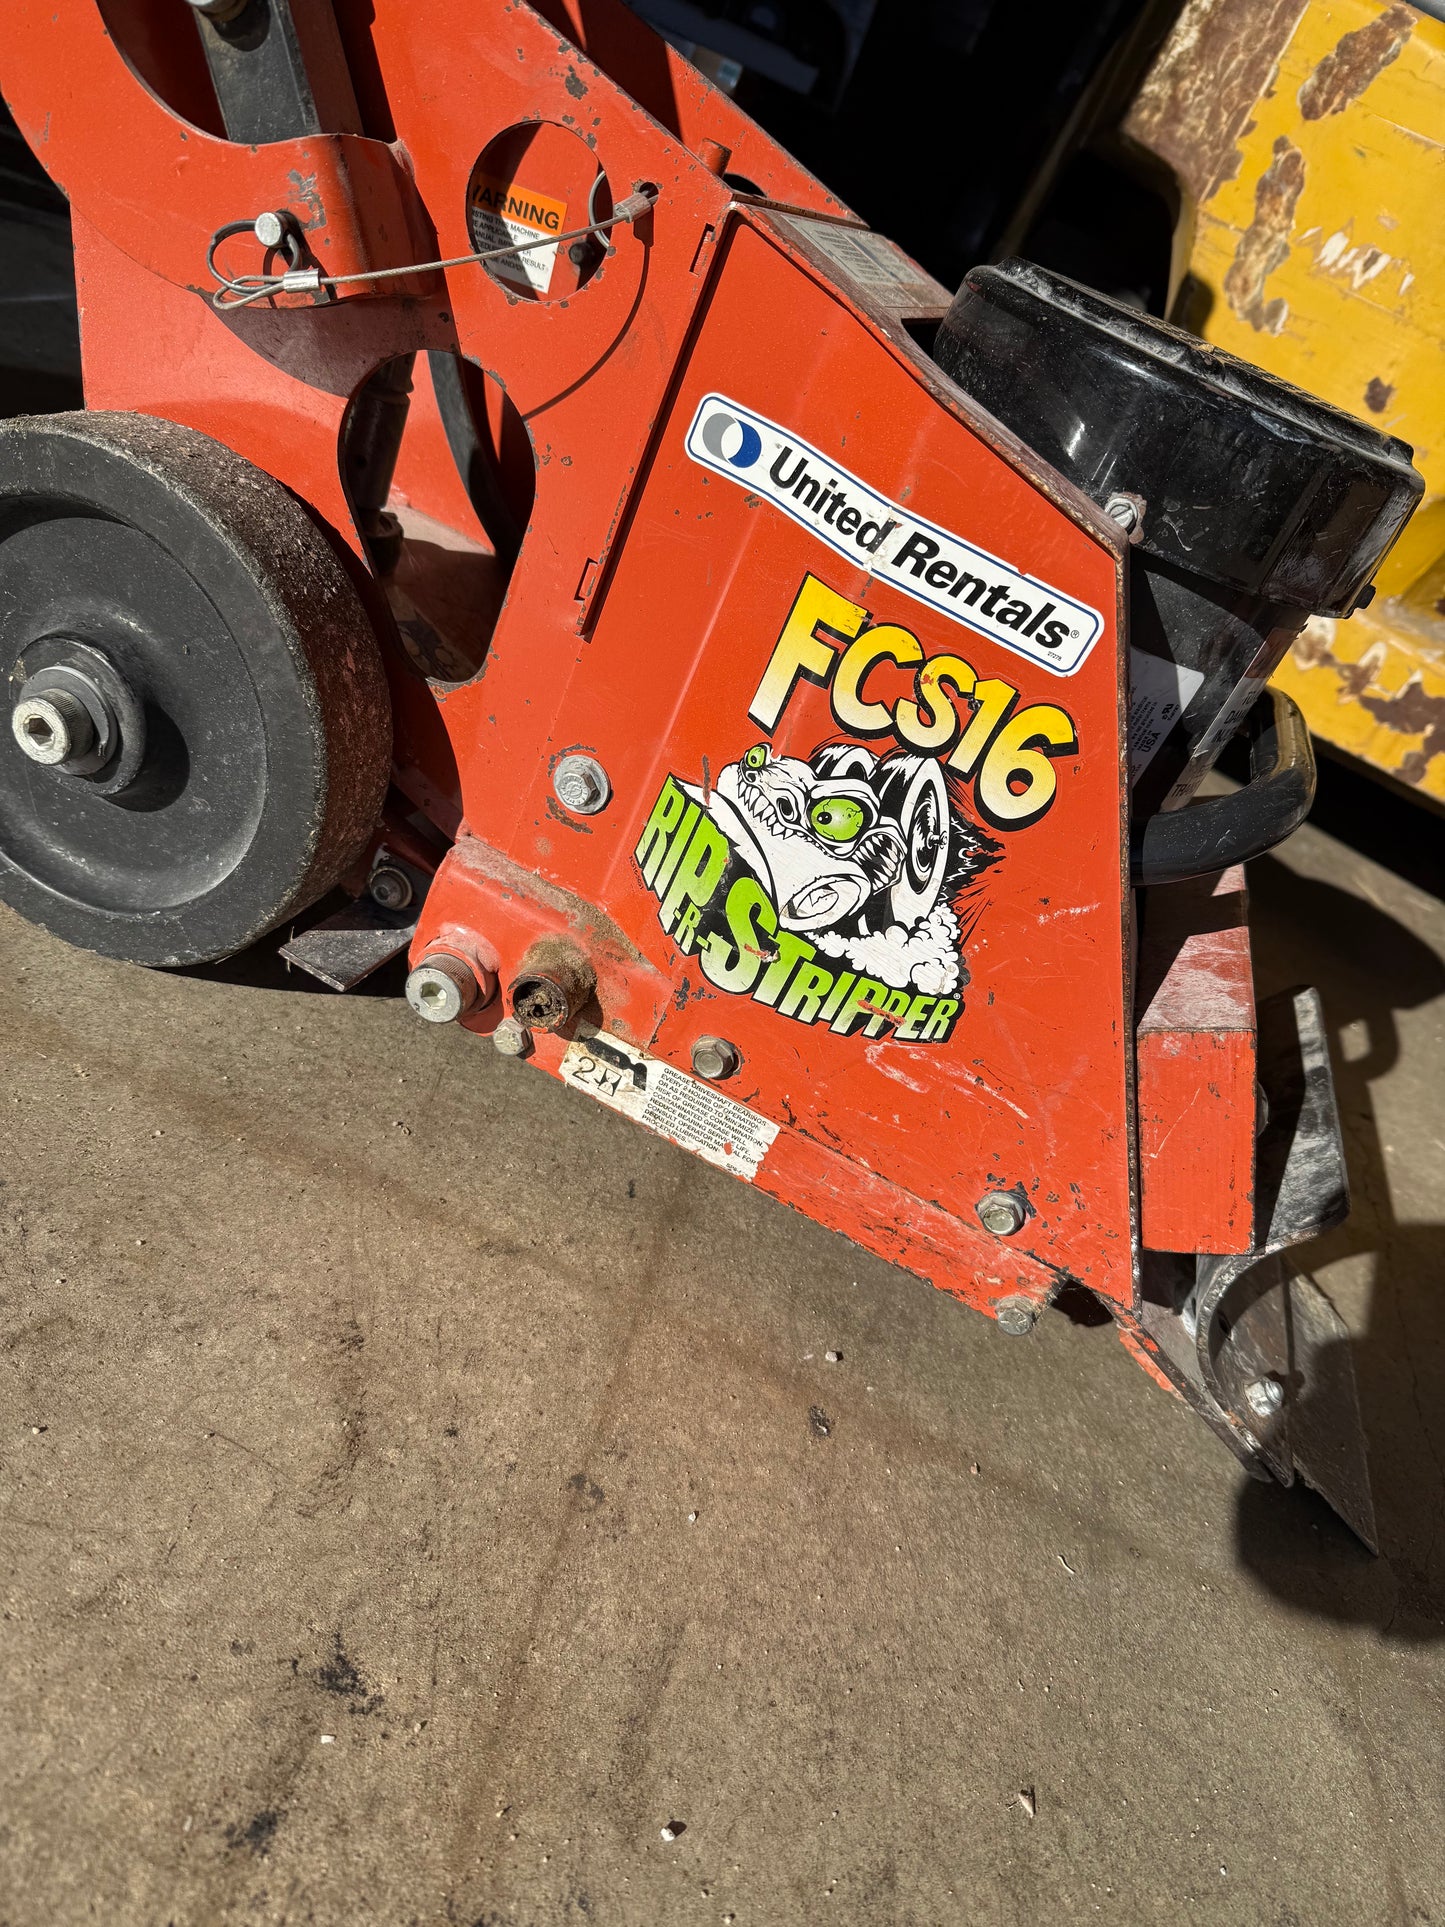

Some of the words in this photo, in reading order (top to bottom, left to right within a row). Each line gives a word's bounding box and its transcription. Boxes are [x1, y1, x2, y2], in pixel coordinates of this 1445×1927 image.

[509, 224, 540, 240] MACHINE
[768, 445, 898, 555] United
[747, 571, 1079, 831] FCS16
[1141, 732, 1161, 752] USA
[655, 1084, 672, 1097] RISK
[671, 1093, 682, 1102] OF
[681, 1099, 709, 1117] GREASE
[658, 1078, 669, 1088] OR
[668, 1084, 679, 1093] AS
[678, 1090, 713, 1112] REQUIRED
[713, 1109, 724, 1118] TO
[723, 1115, 754, 1135] MINMIZE
[660, 1073, 682, 1088] EVERY
[687, 1087, 712, 1104] HOURS
[663, 1066, 691, 1085] GREASE
[690, 1082, 731, 1107] DRIVESHAFT
[732, 1105, 766, 1127] BEARINGS
[641, 1113, 688, 1142] PROCEDURES.
[644, 1107, 675, 1128] DETAILED
[675, 1125, 718, 1152] LUBRICATION
[646, 1102, 677, 1122] CONSULT
[677, 1119, 713, 1142] OPERATOR
[713, 1138, 742, 1158] MAAL
[741, 1154, 756, 1166] FOR
[649, 1096, 677, 1115] REDUCE
[677, 1111, 707, 1131] BEARING
[652, 1090, 703, 1121] CONTAMINATED
[702, 1118, 730, 1136] GREASE
[730, 1133, 747, 1146] WILL
